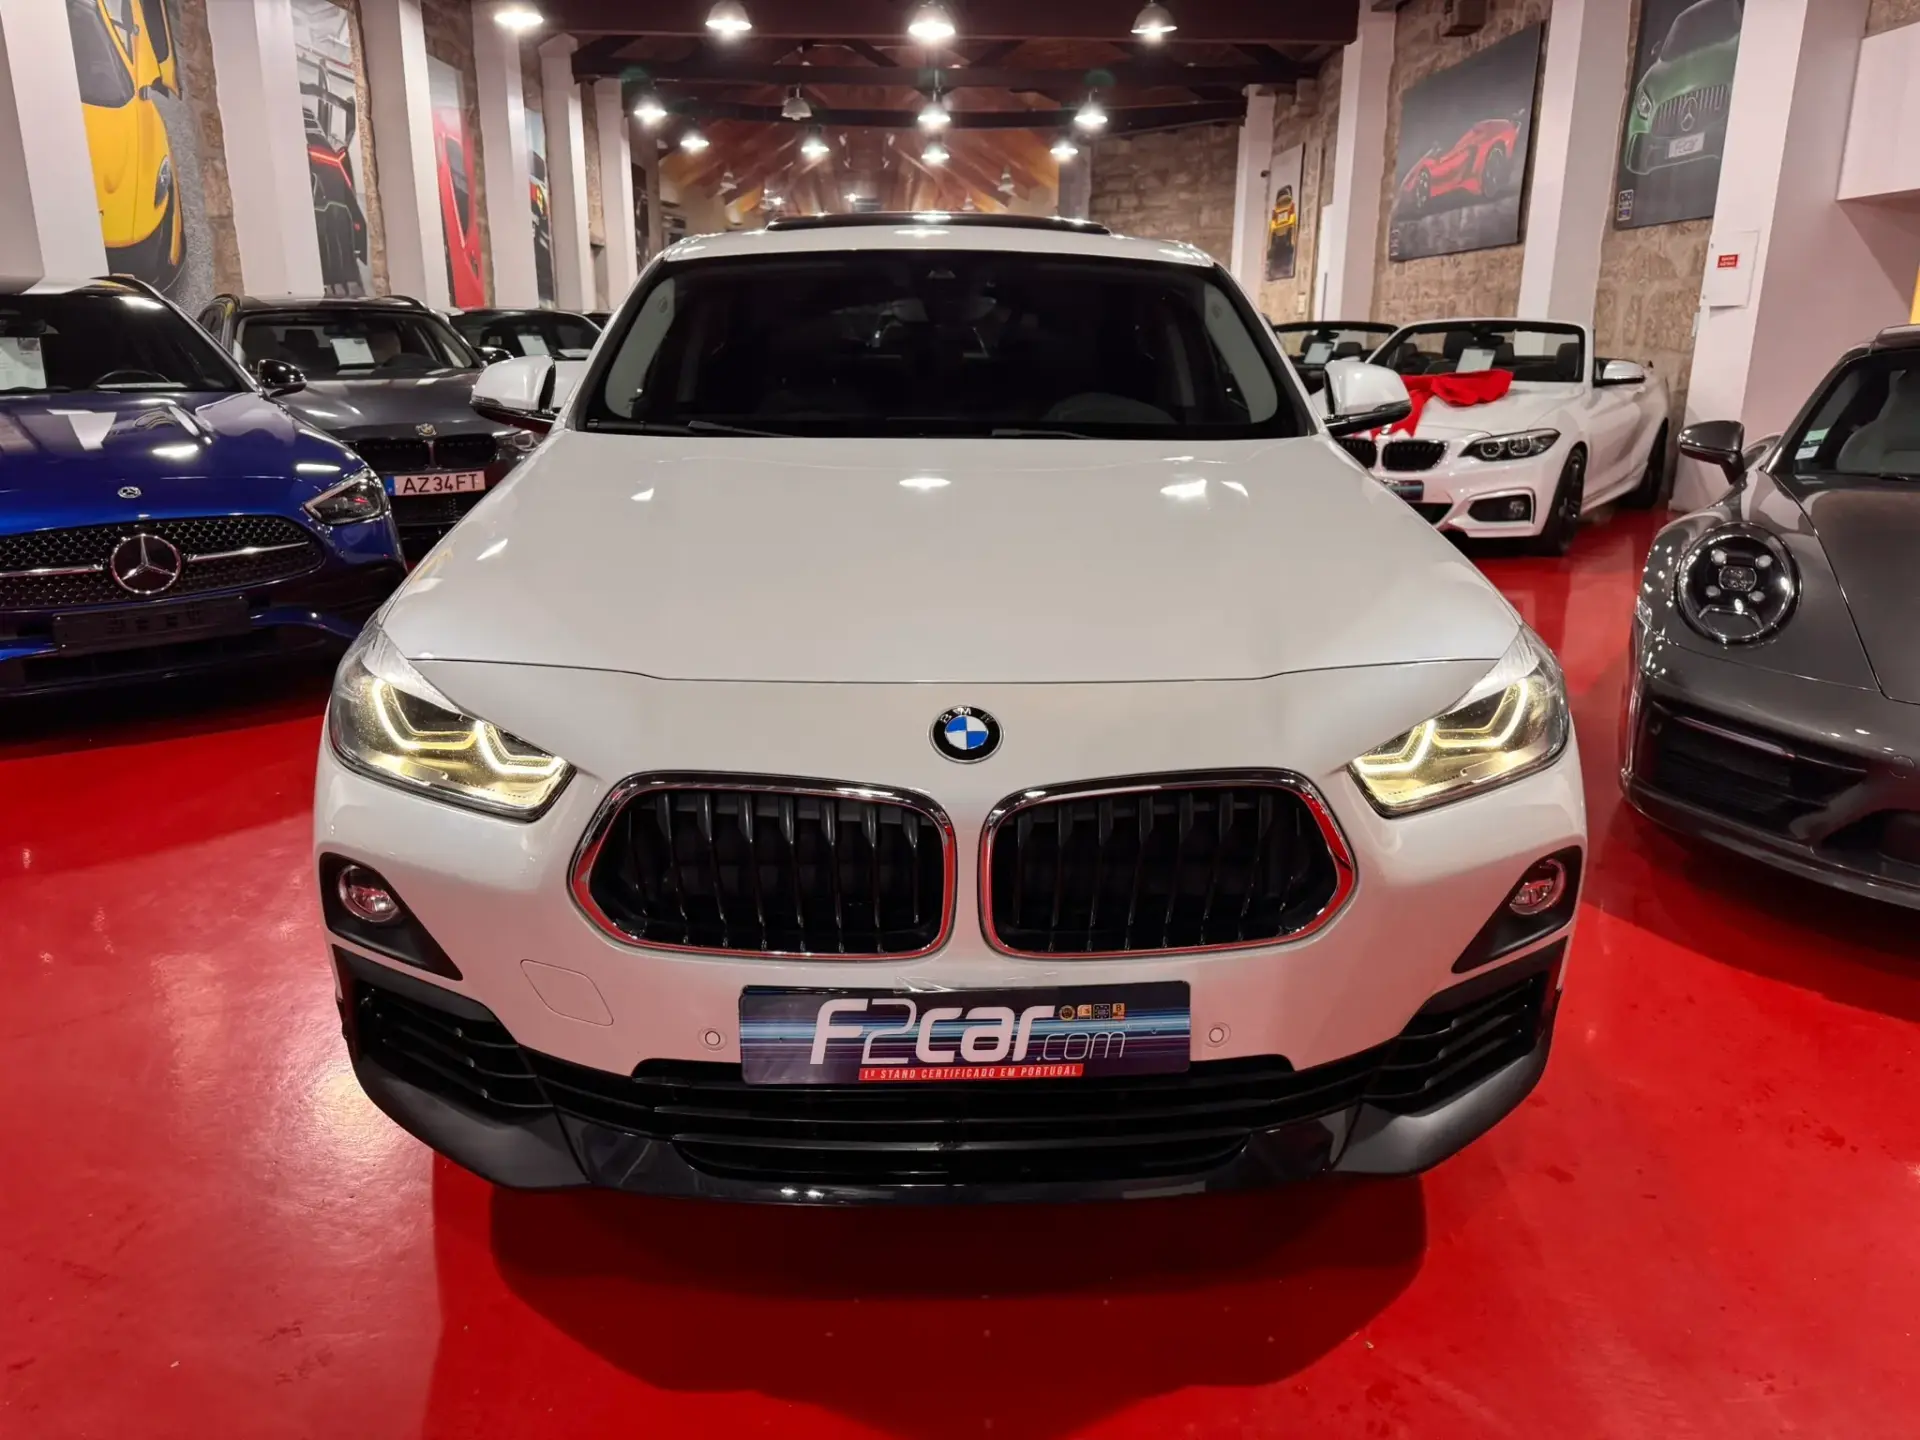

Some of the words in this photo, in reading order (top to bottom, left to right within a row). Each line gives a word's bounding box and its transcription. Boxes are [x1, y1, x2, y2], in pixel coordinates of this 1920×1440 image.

[880, 1069, 916, 1079] STAND
[921, 1067, 995, 1079] CERTIFICADO
[1000, 1067, 1016, 1077] EM
[1020, 1065, 1076, 1077] PORTUGAL
